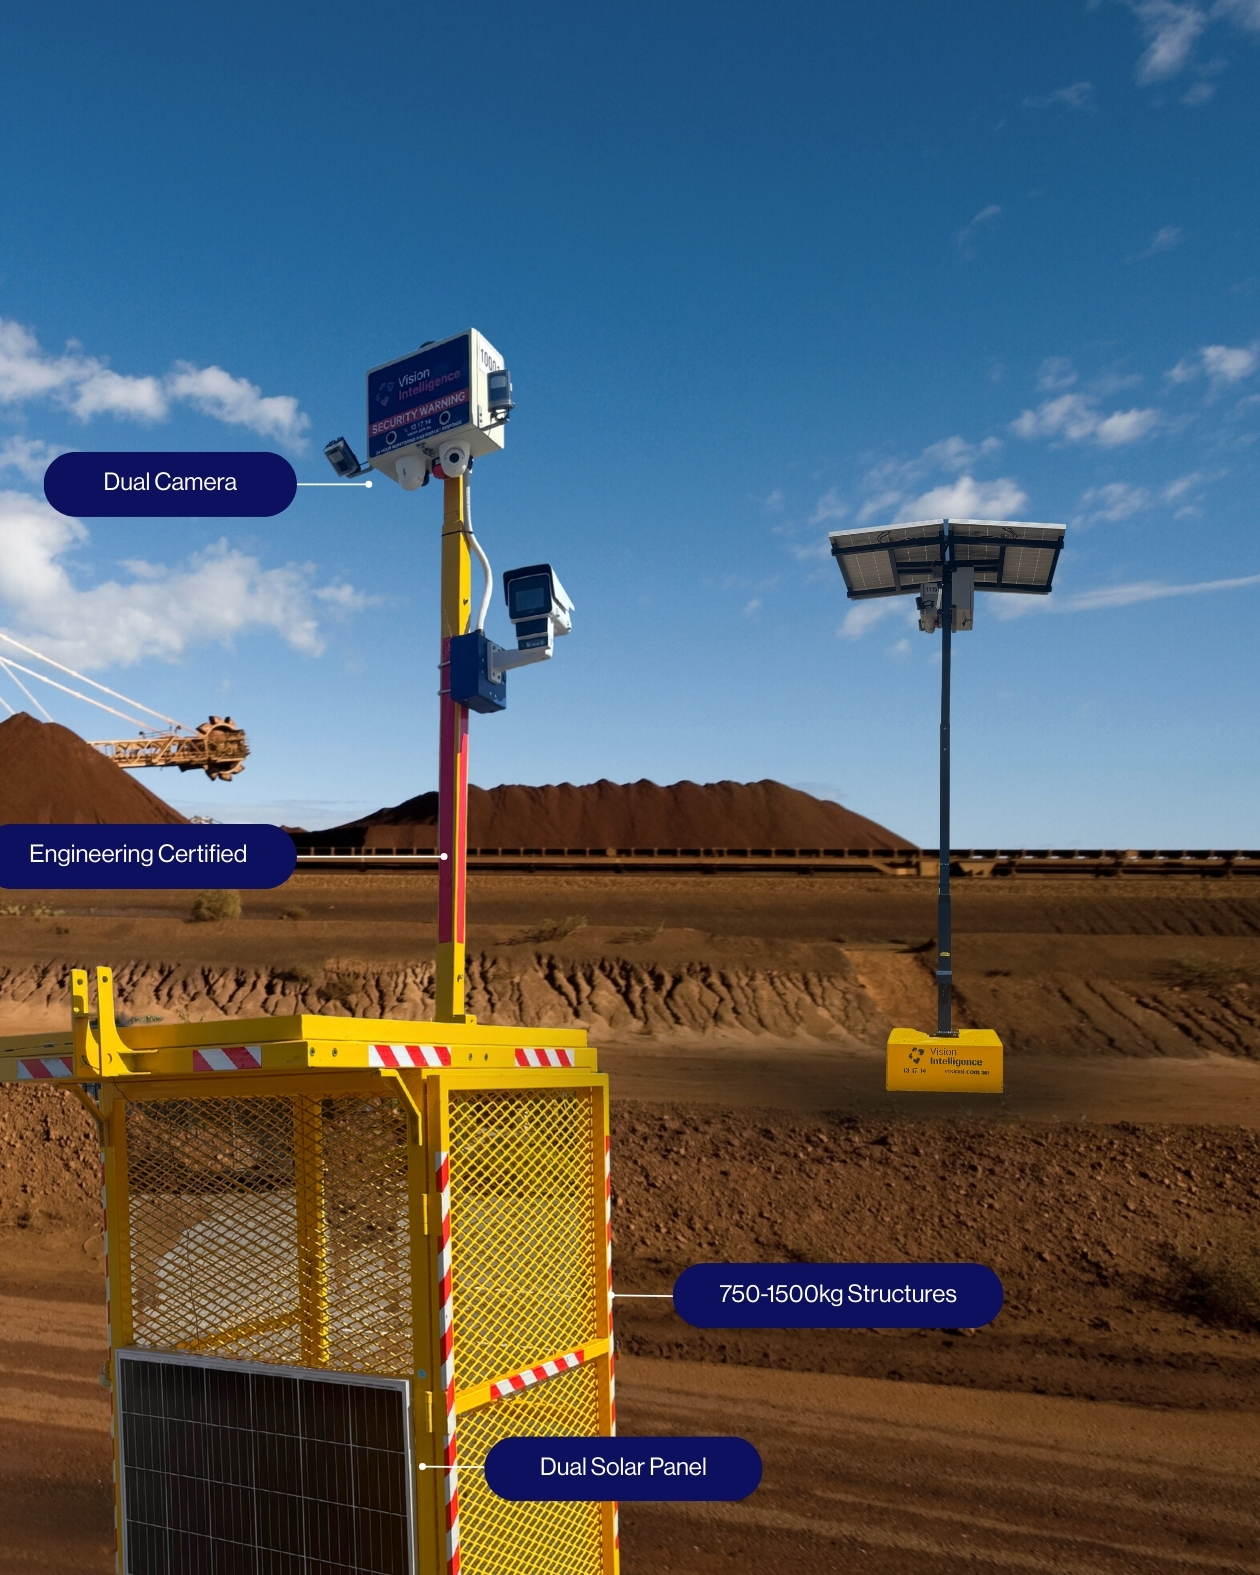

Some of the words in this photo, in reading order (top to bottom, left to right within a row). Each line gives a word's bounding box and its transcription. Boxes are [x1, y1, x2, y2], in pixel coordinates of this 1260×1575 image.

[398, 368, 430, 388] Vision
[398, 370, 461, 401] Intelligence
[372, 408, 418, 434] SECURITY
[419, 391, 466, 416] WARNING
[380, 445, 392, 454] HOUR
[391, 436, 416, 449] MONITORING
[415, 434, 425, 443] AND
[441, 419, 462, 431] RESPONSE
[930, 1047, 957, 1056] Vision
[930, 1057, 983, 1067] Intelligence
